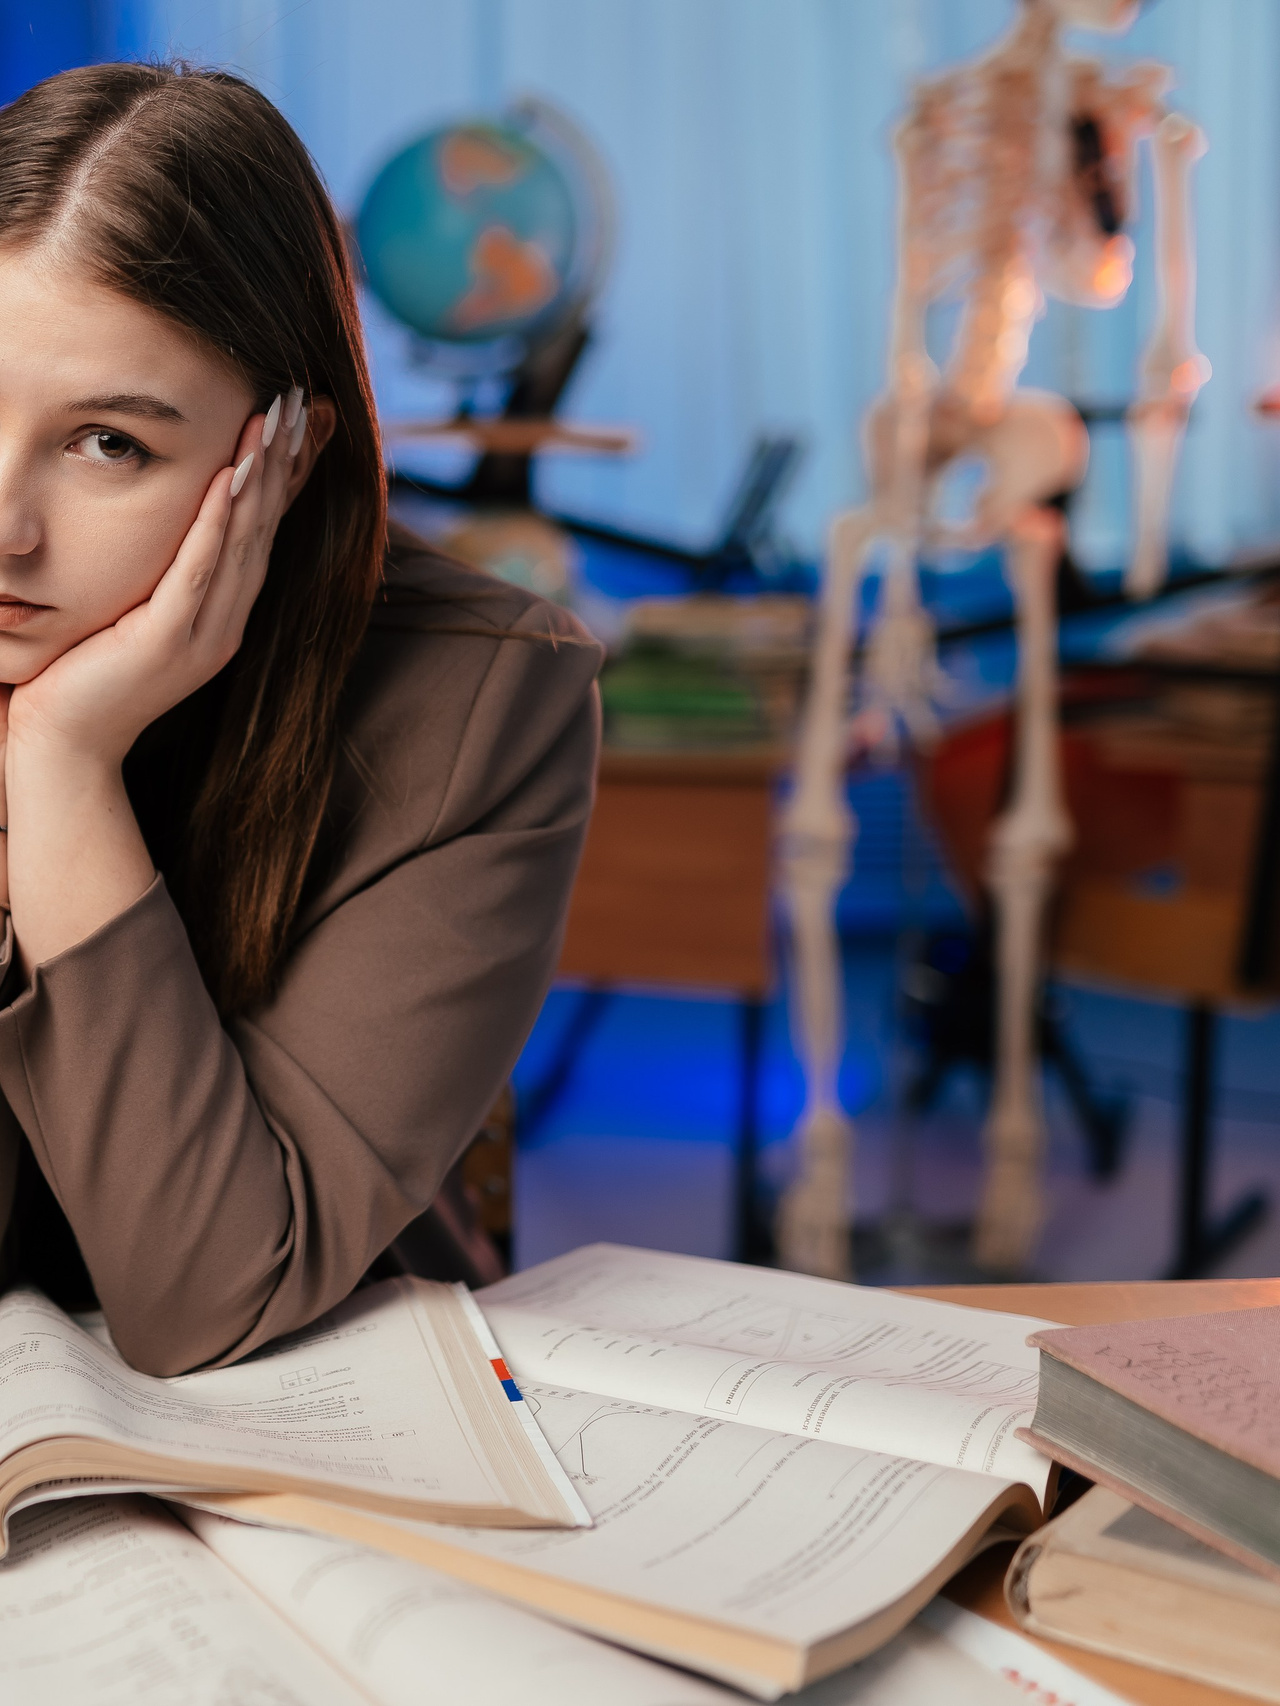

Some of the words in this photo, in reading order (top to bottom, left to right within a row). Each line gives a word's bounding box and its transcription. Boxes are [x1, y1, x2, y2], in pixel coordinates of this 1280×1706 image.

[725, 1368, 756, 1406] фрагмента
[801, 1382, 836, 1432] получившуюся
[813, 1390, 841, 1434] увеличения
[956, 1432, 974, 1467] горных
[984, 1433, 1005, 1474] ВАРИАНТЫ
